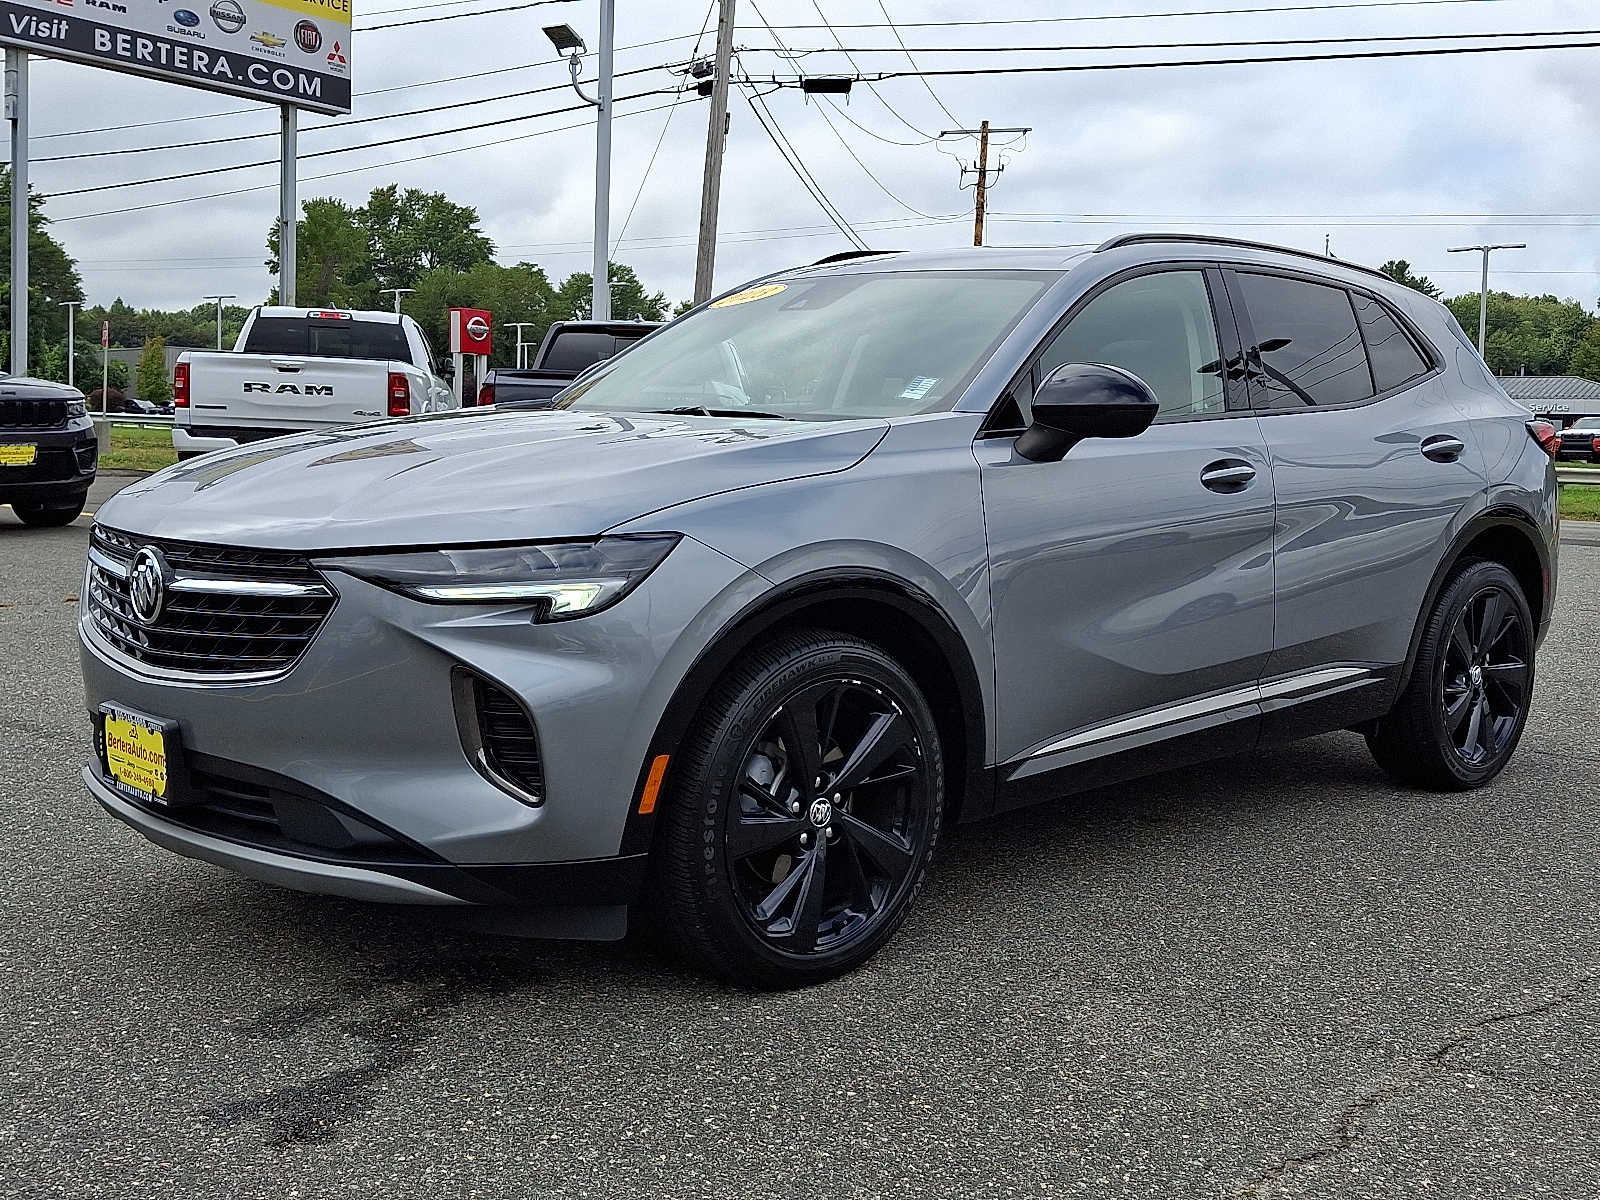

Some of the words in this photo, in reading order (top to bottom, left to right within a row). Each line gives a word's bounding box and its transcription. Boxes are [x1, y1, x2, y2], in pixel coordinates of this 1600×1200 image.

[214, 10, 244, 23] NISSAN
[166, 25, 206, 39] SUBARU
[301, 28, 317, 47] FIAT
[9, 13, 69, 40] Visit
[94, 28, 321, 98] BERTERA.COM
[251, 45, 286, 57] CHEVROLET
[243, 381, 334, 396] RAM
[1529, 403, 1569, 411] Service
